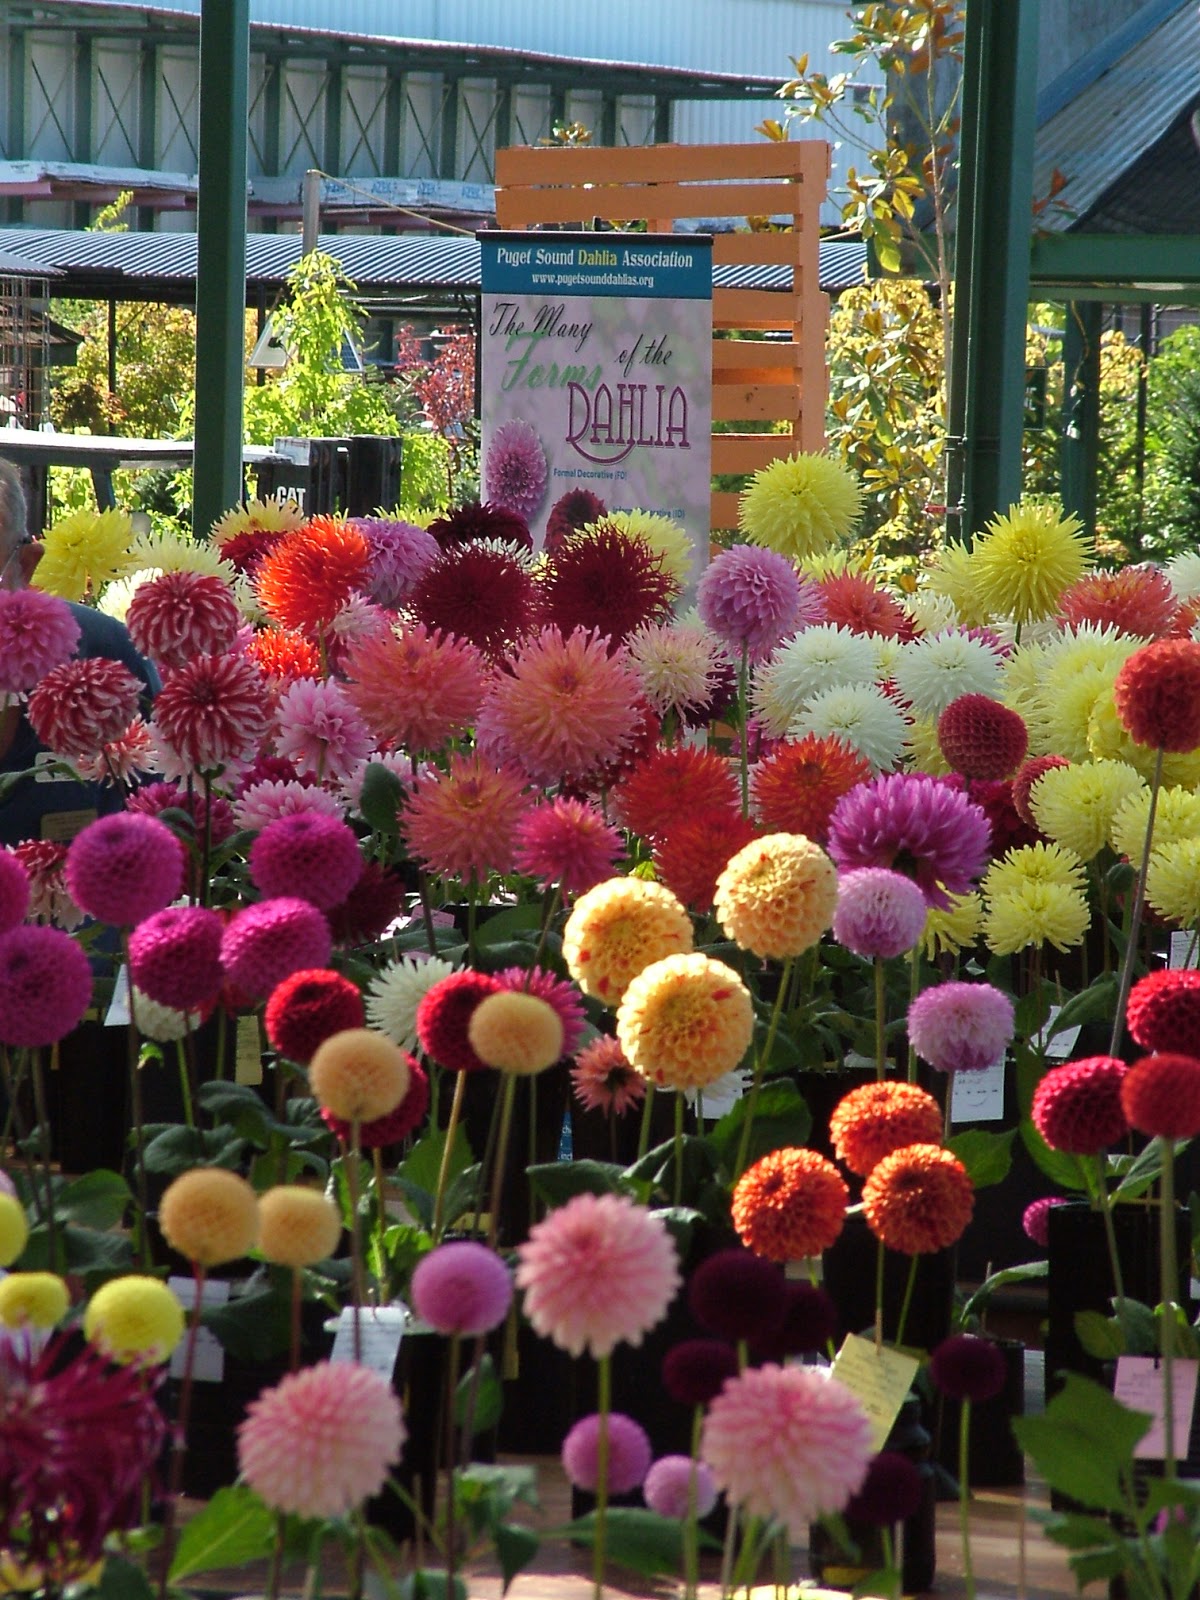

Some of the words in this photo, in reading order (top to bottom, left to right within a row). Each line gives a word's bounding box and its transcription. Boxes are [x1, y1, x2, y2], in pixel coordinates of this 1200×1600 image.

[497, 247, 532, 267] Puget
[535, 248, 574, 265] Sound
[578, 249, 617, 266] Dahlia
[622, 250, 693, 267] Association
[532, 272, 654, 288] www.pugetsounddahlias.org
[489, 302, 525, 336] The
[533, 303, 593, 353] Many
[501, 331, 602, 391] Forms
[614, 333, 644, 378] of
[640, 334, 672, 365] the
[566, 382, 690, 464] DAHLIA
[553, 468, 576, 478] Formal
[577, 469, 613, 480] Decorative
[277, 486, 306, 509] CAT
